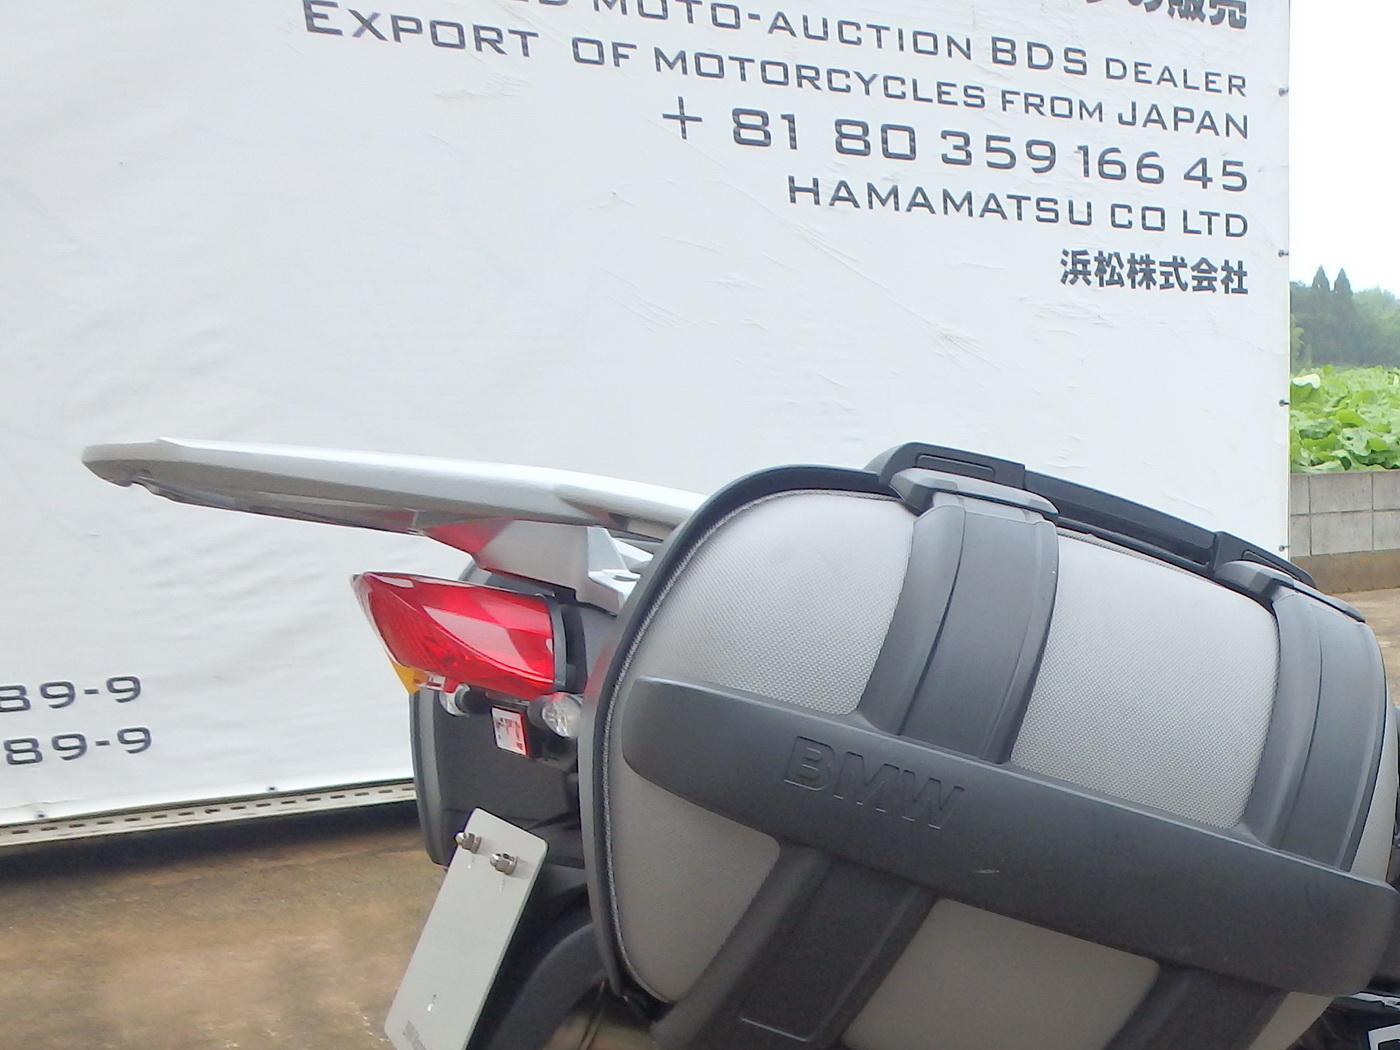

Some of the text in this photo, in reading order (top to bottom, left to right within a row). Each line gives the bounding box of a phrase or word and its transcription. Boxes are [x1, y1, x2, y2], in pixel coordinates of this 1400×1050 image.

[302, 0, 1248, 140] EXPORT OF MOTORCYCLES FROM JAPAN
[991, 36, 1088, 76] BDS
[1105, 57, 1247, 98] DEALER
[731, 107, 798, 151] 81
[834, 118, 917, 162] 80
[940, 129, 1057, 175] 359
[1073, 144, 1165, 185] 166
[1183, 157, 1248, 193] 45
[787, 175, 1249, 238] HAMAMATSU CO LTD
[1059, 248, 1249, 295] 浜松株式会社
[3, 726, 153, 766] 89-9
[783, 735, 966, 830] BMW
